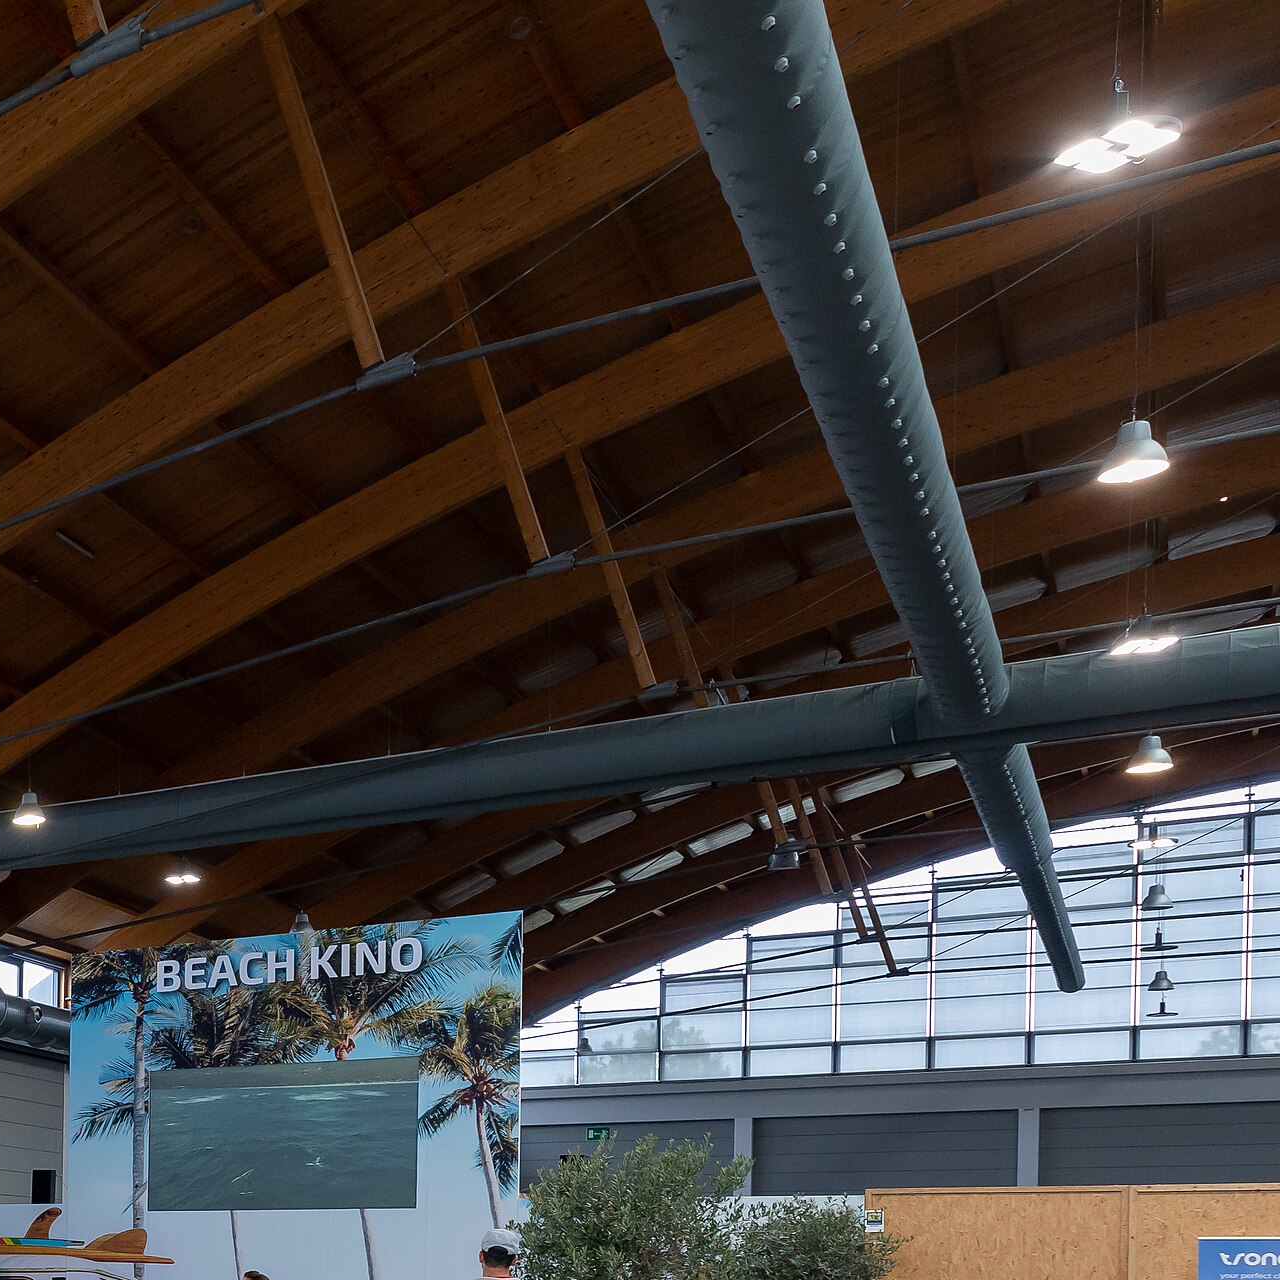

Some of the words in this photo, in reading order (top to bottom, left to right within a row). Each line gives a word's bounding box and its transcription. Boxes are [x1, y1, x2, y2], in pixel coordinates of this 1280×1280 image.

[156, 948, 295, 993] BEACH
[310, 937, 423, 980] KINO
[1219, 1252, 1280, 1266] tron
[1240, 1272, 1271, 1280] perfect
